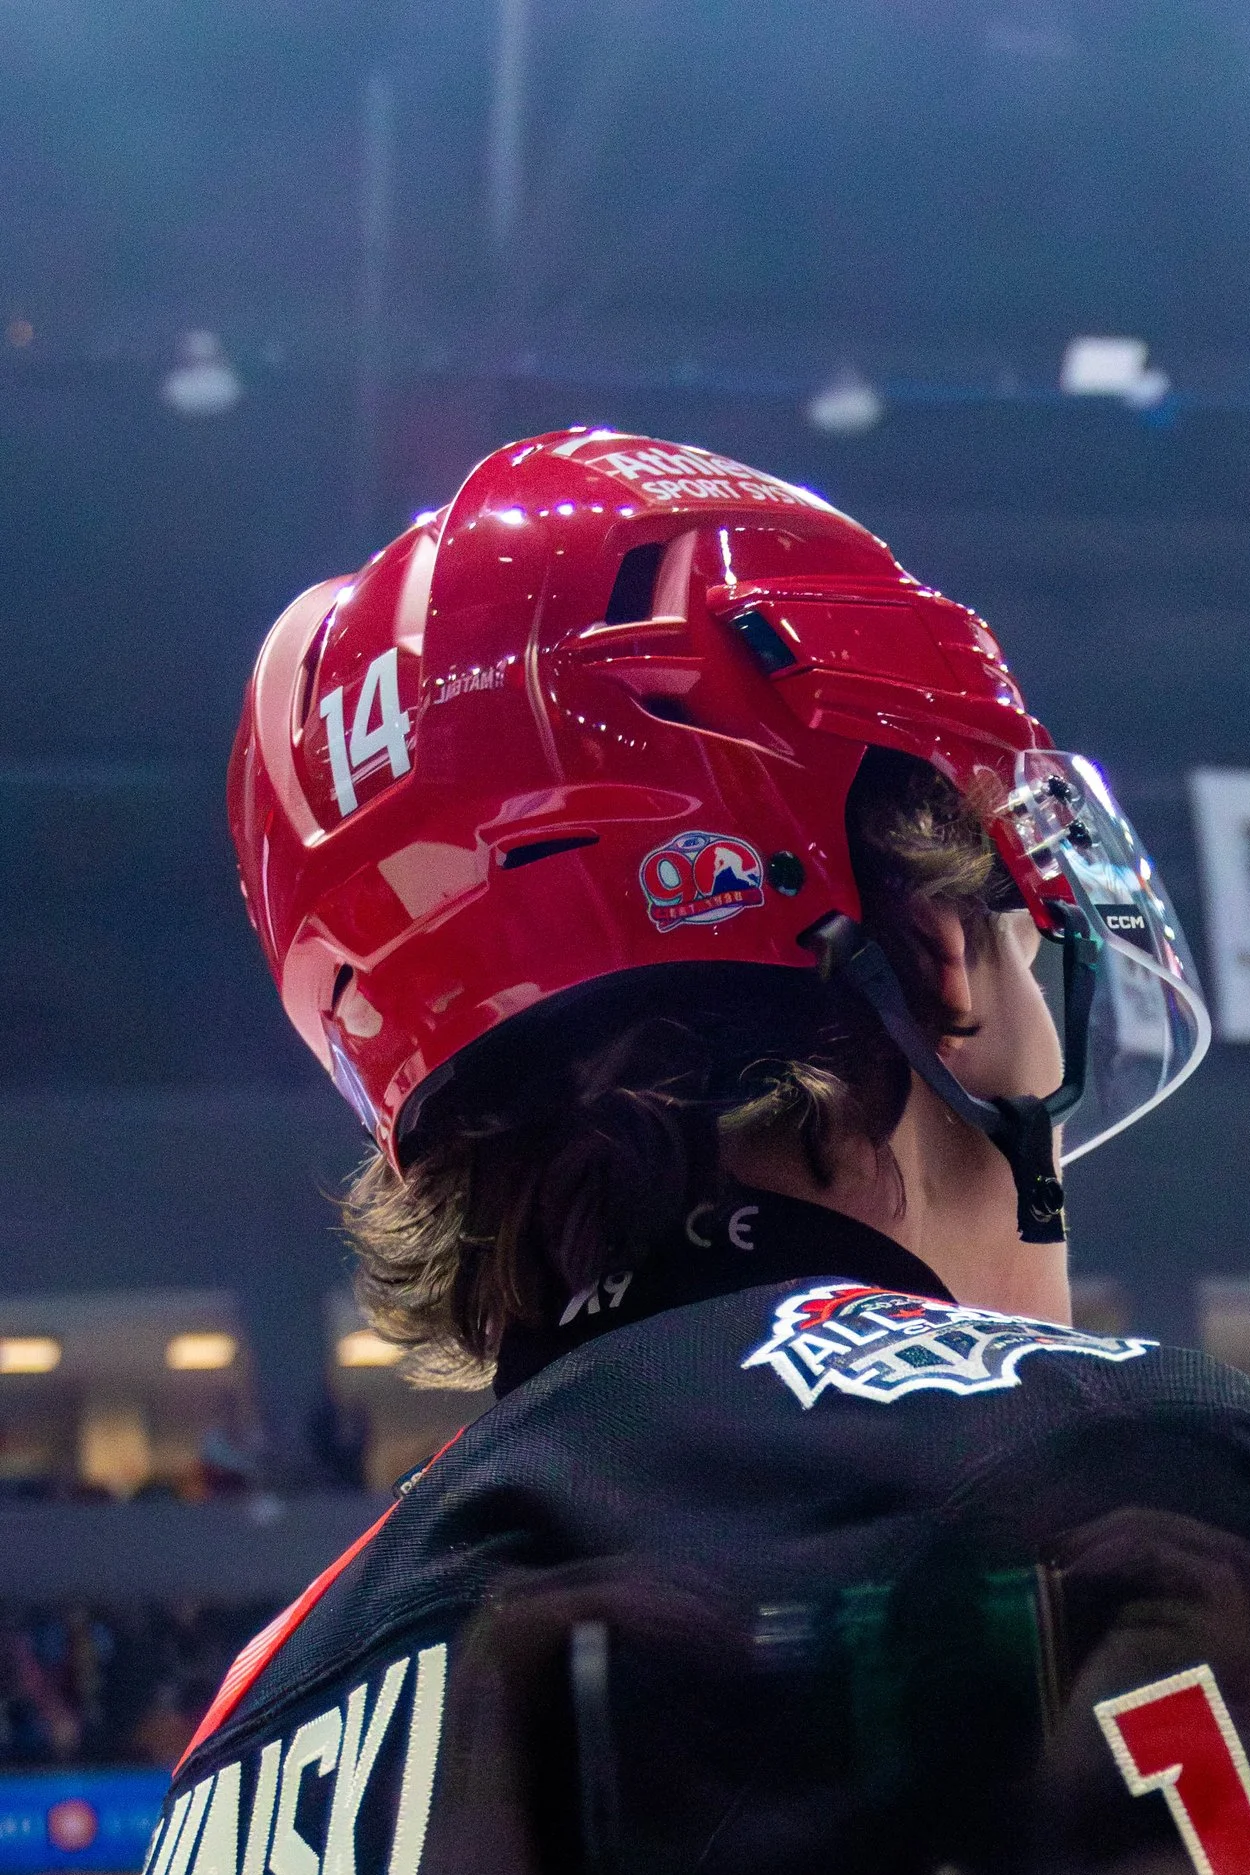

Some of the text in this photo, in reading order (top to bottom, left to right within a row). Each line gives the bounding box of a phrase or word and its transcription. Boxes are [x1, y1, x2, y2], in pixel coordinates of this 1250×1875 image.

[642, 479, 741, 500] SPORT
[319, 647, 411, 818] 14
[1106, 915, 1145, 929] CCM
[789, 1311, 927, 1376] ALL
